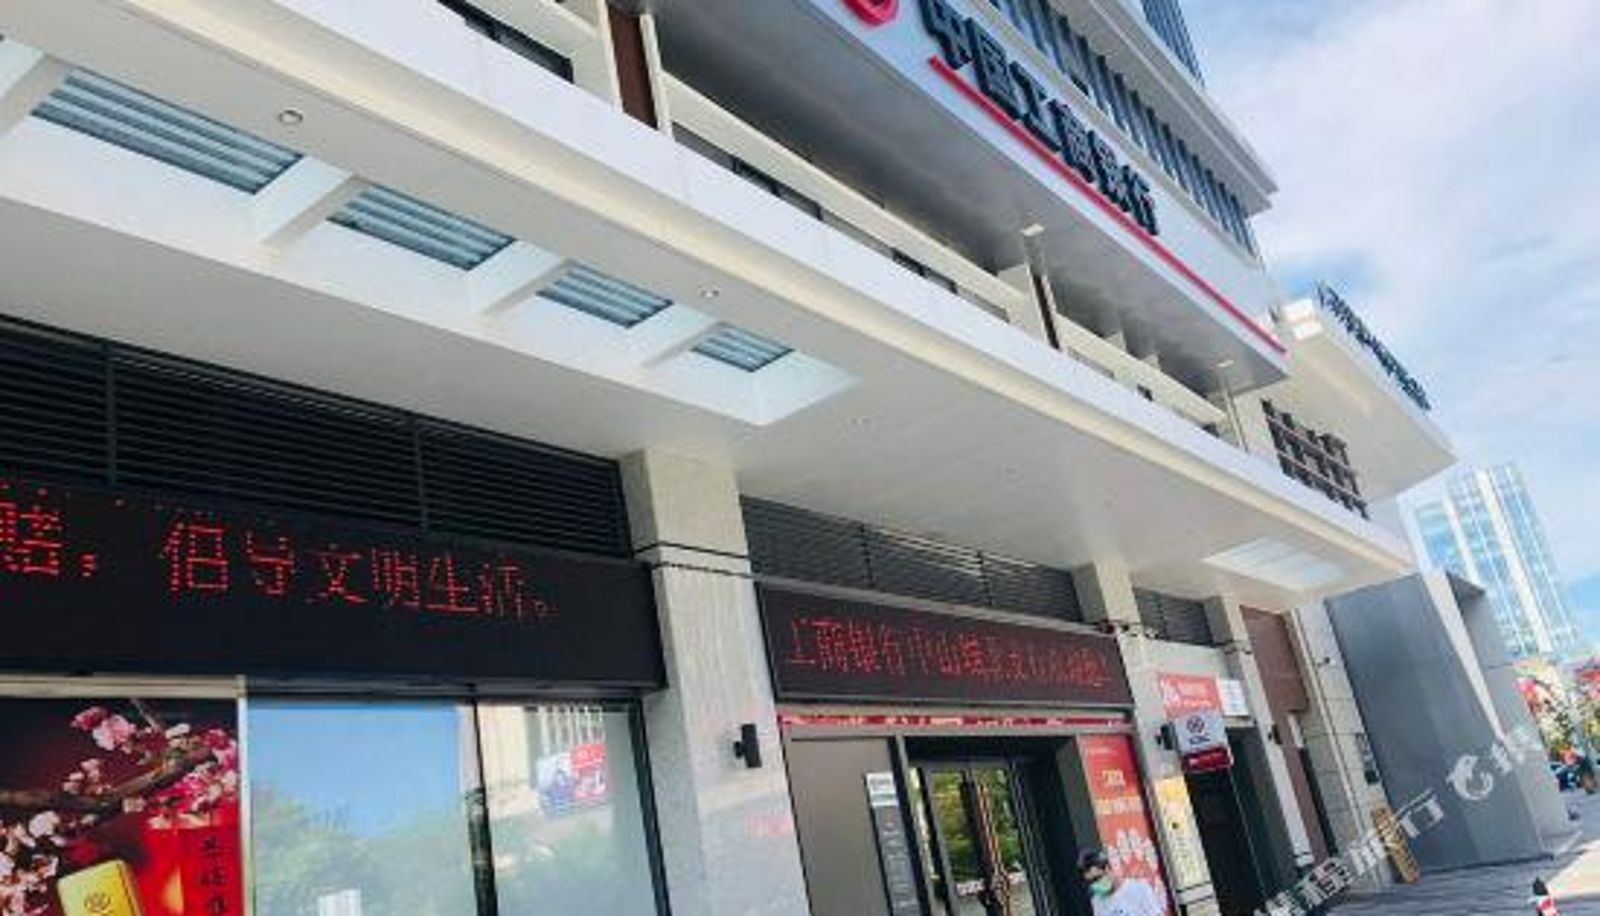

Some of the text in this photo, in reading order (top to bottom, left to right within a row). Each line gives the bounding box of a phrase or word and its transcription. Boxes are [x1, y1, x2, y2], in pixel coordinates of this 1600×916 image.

[919, 0, 1158, 235] 中国工商银行
